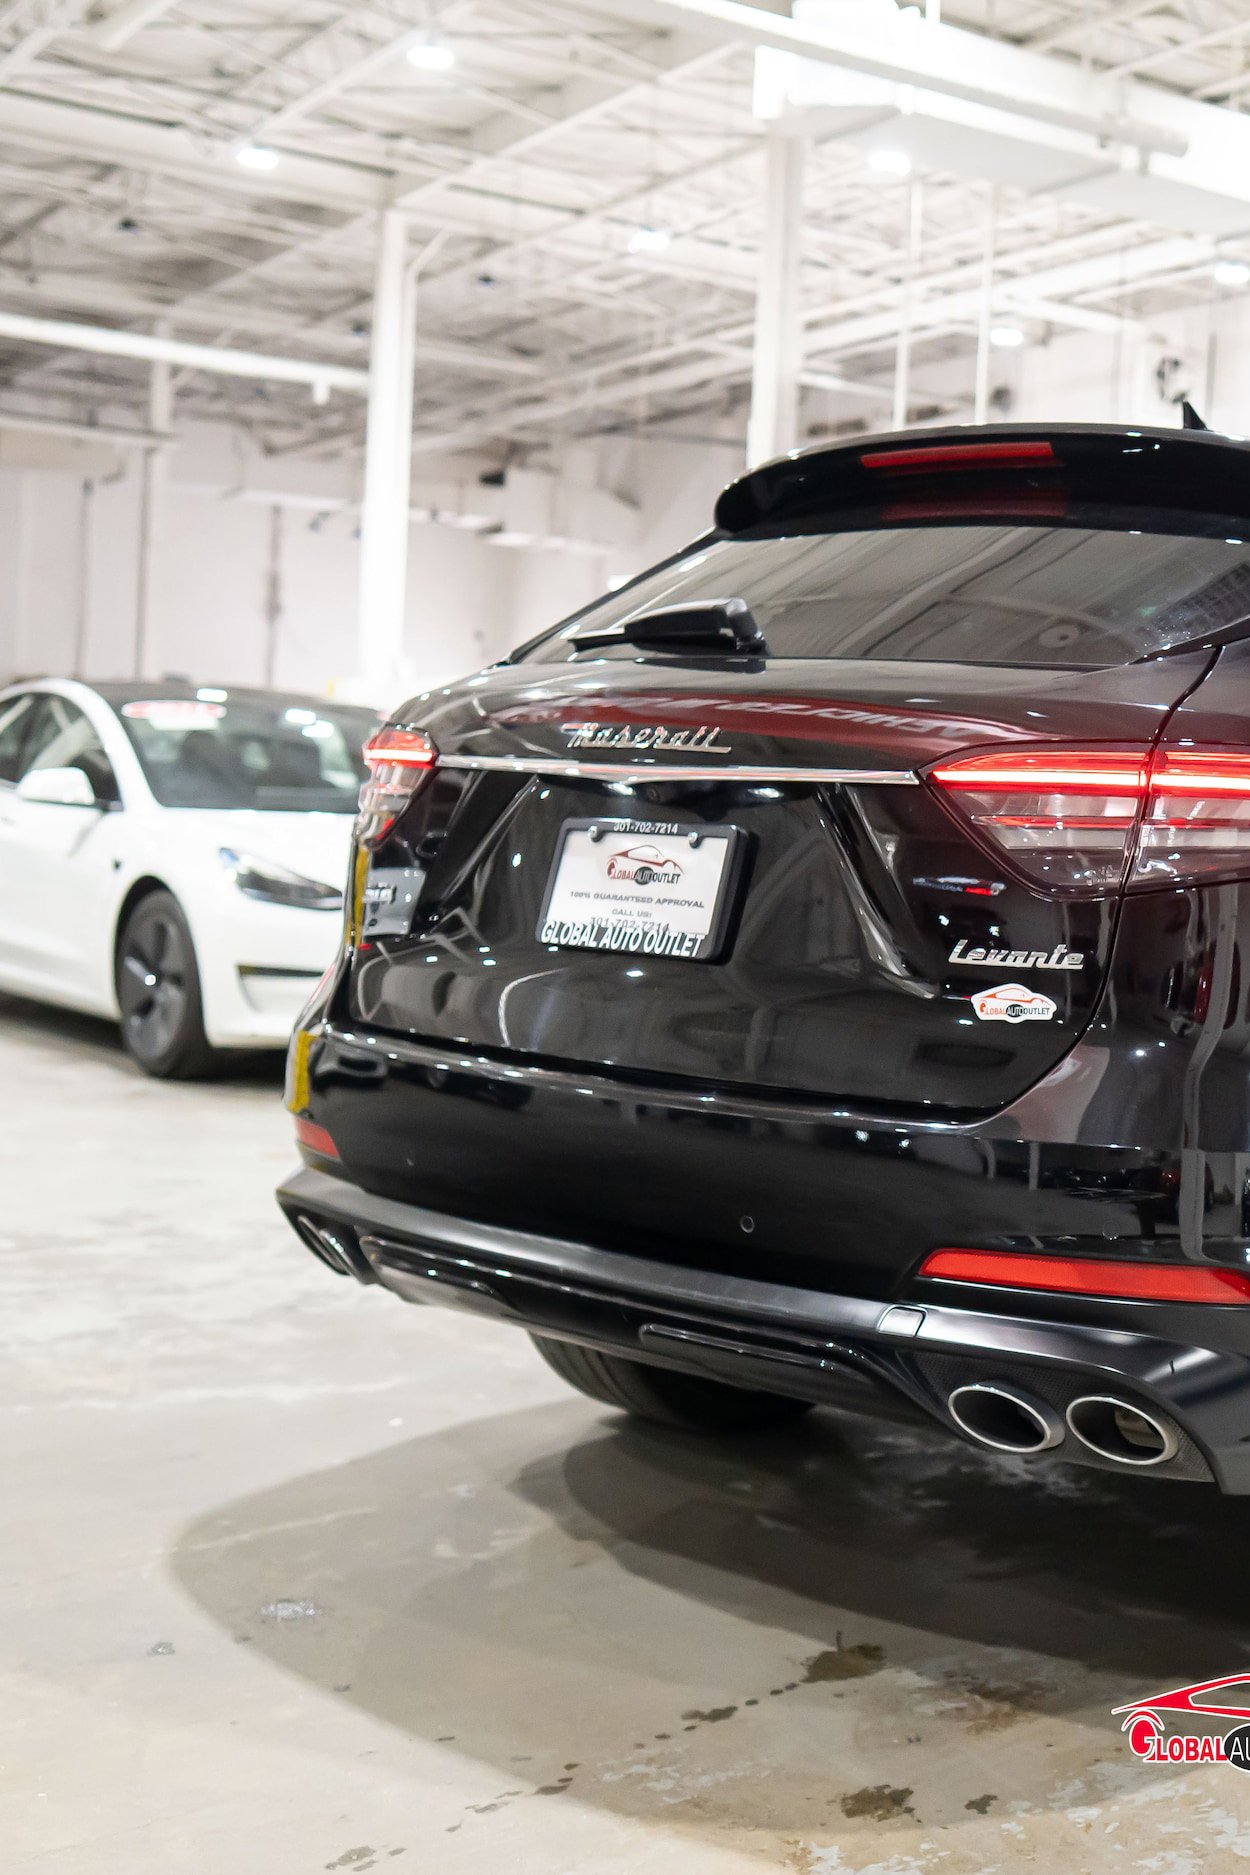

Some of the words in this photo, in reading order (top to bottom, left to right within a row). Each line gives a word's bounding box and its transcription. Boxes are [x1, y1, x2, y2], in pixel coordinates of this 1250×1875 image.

[561, 722, 731, 753] Maserati
[613, 822, 679, 834] 301-702-7214
[570, 891, 590, 899] 100%
[594, 893, 653, 904] GUARANTEED
[655, 898, 705, 908] APPROVAL
[612, 908, 634, 917] CALL
[541, 920, 599, 948] GLOBAL
[599, 924, 644, 952] AUTO
[643, 929, 706, 958] OUTLET
[949, 939, 1084, 970] Levante
